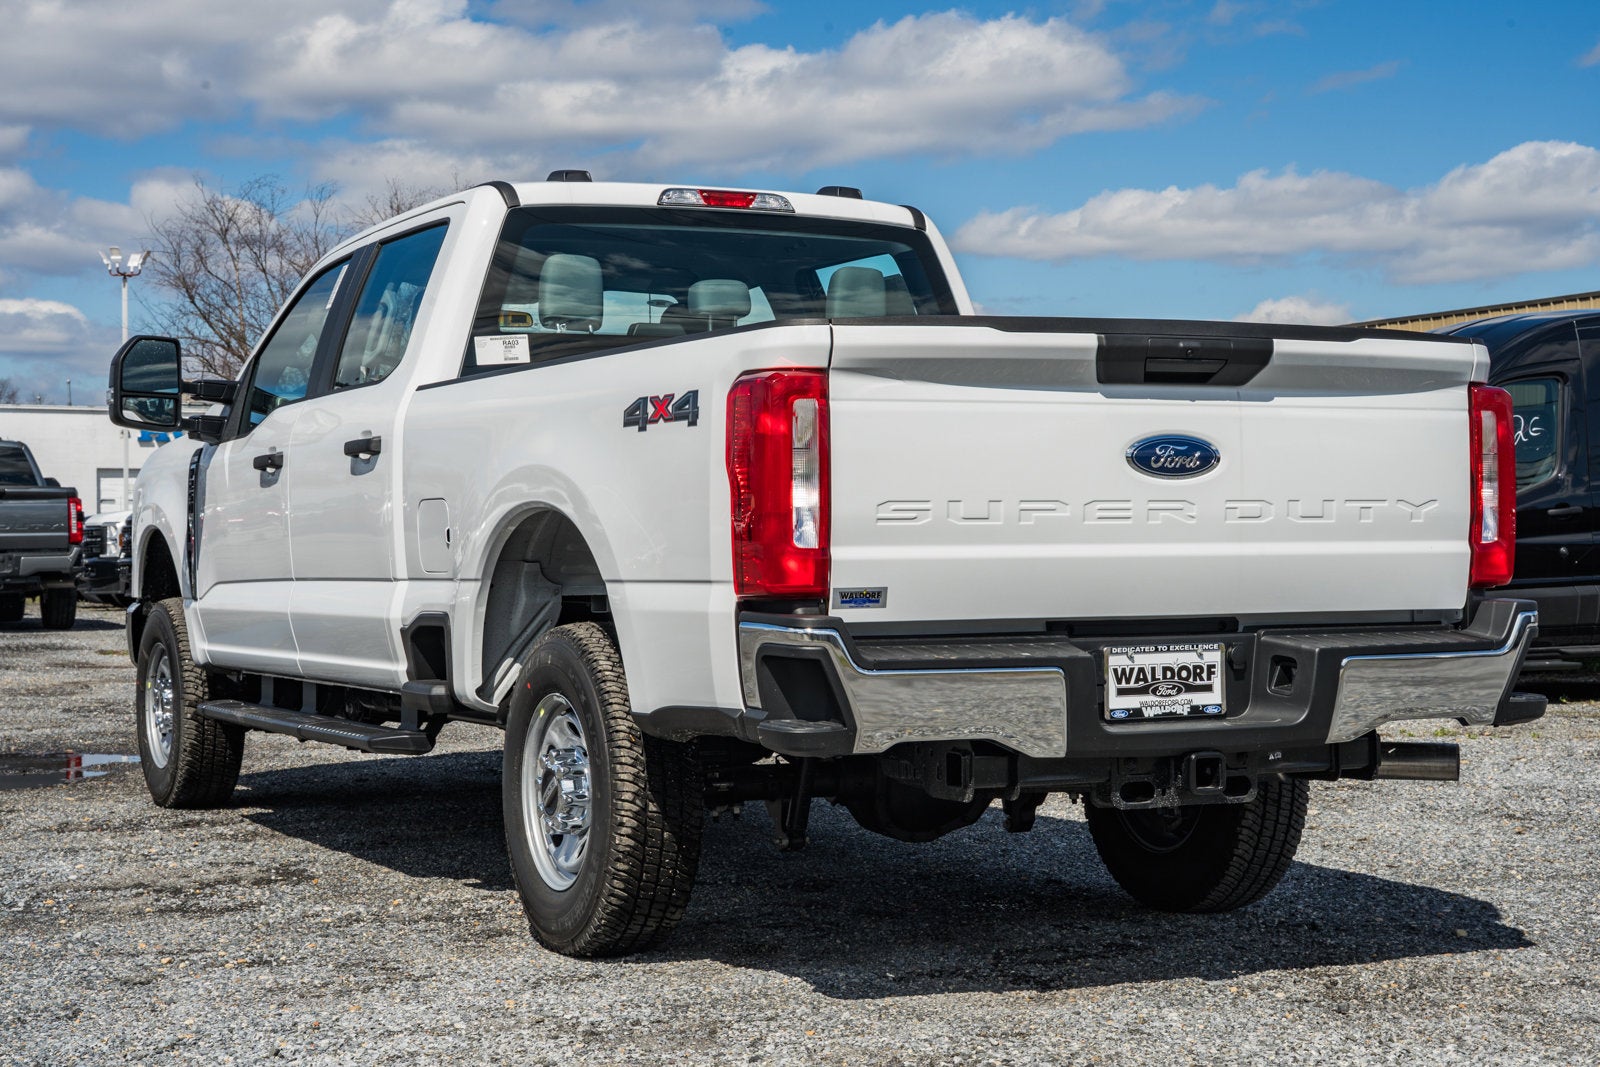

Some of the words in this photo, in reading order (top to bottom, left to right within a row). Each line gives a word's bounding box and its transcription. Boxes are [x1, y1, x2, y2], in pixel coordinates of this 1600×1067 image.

[1150, 443, 1200, 471] Ford
[876, 498, 1198, 526] SUPER
[1224, 497, 1440, 525] DUTY
[839, 591, 882, 599] WALDORF
[1112, 645, 1155, 654] DEDICATED
[1169, 643, 1219, 651] EXCELLENCE
[1112, 663, 1217, 686] WALDORF
[1156, 684, 1178, 696] Ford
[1141, 704, 1191, 717] WALDORF
